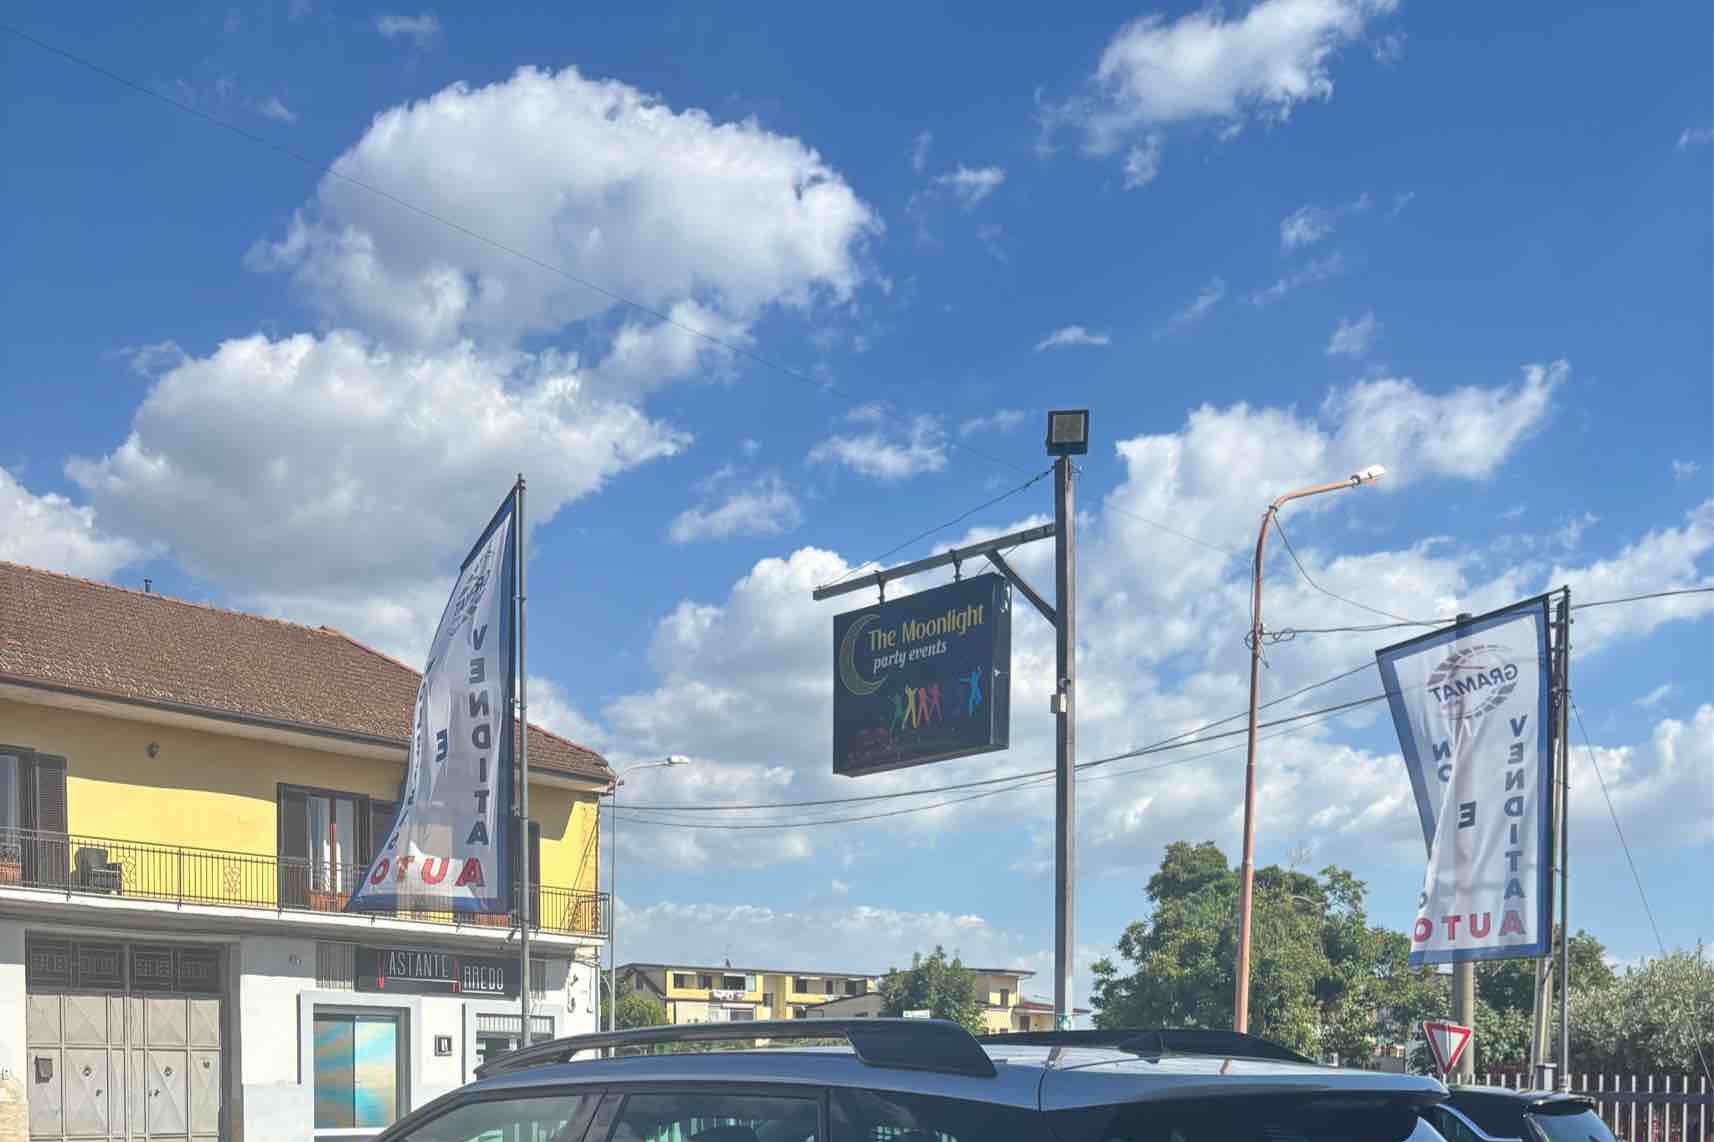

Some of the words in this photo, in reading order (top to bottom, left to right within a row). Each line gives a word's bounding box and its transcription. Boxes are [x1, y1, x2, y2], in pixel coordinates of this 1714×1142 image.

[868, 628, 896, 651] The
[902, 604, 984, 643] Moonlight
[872, 650, 907, 675] party
[909, 639, 947, 661] events
